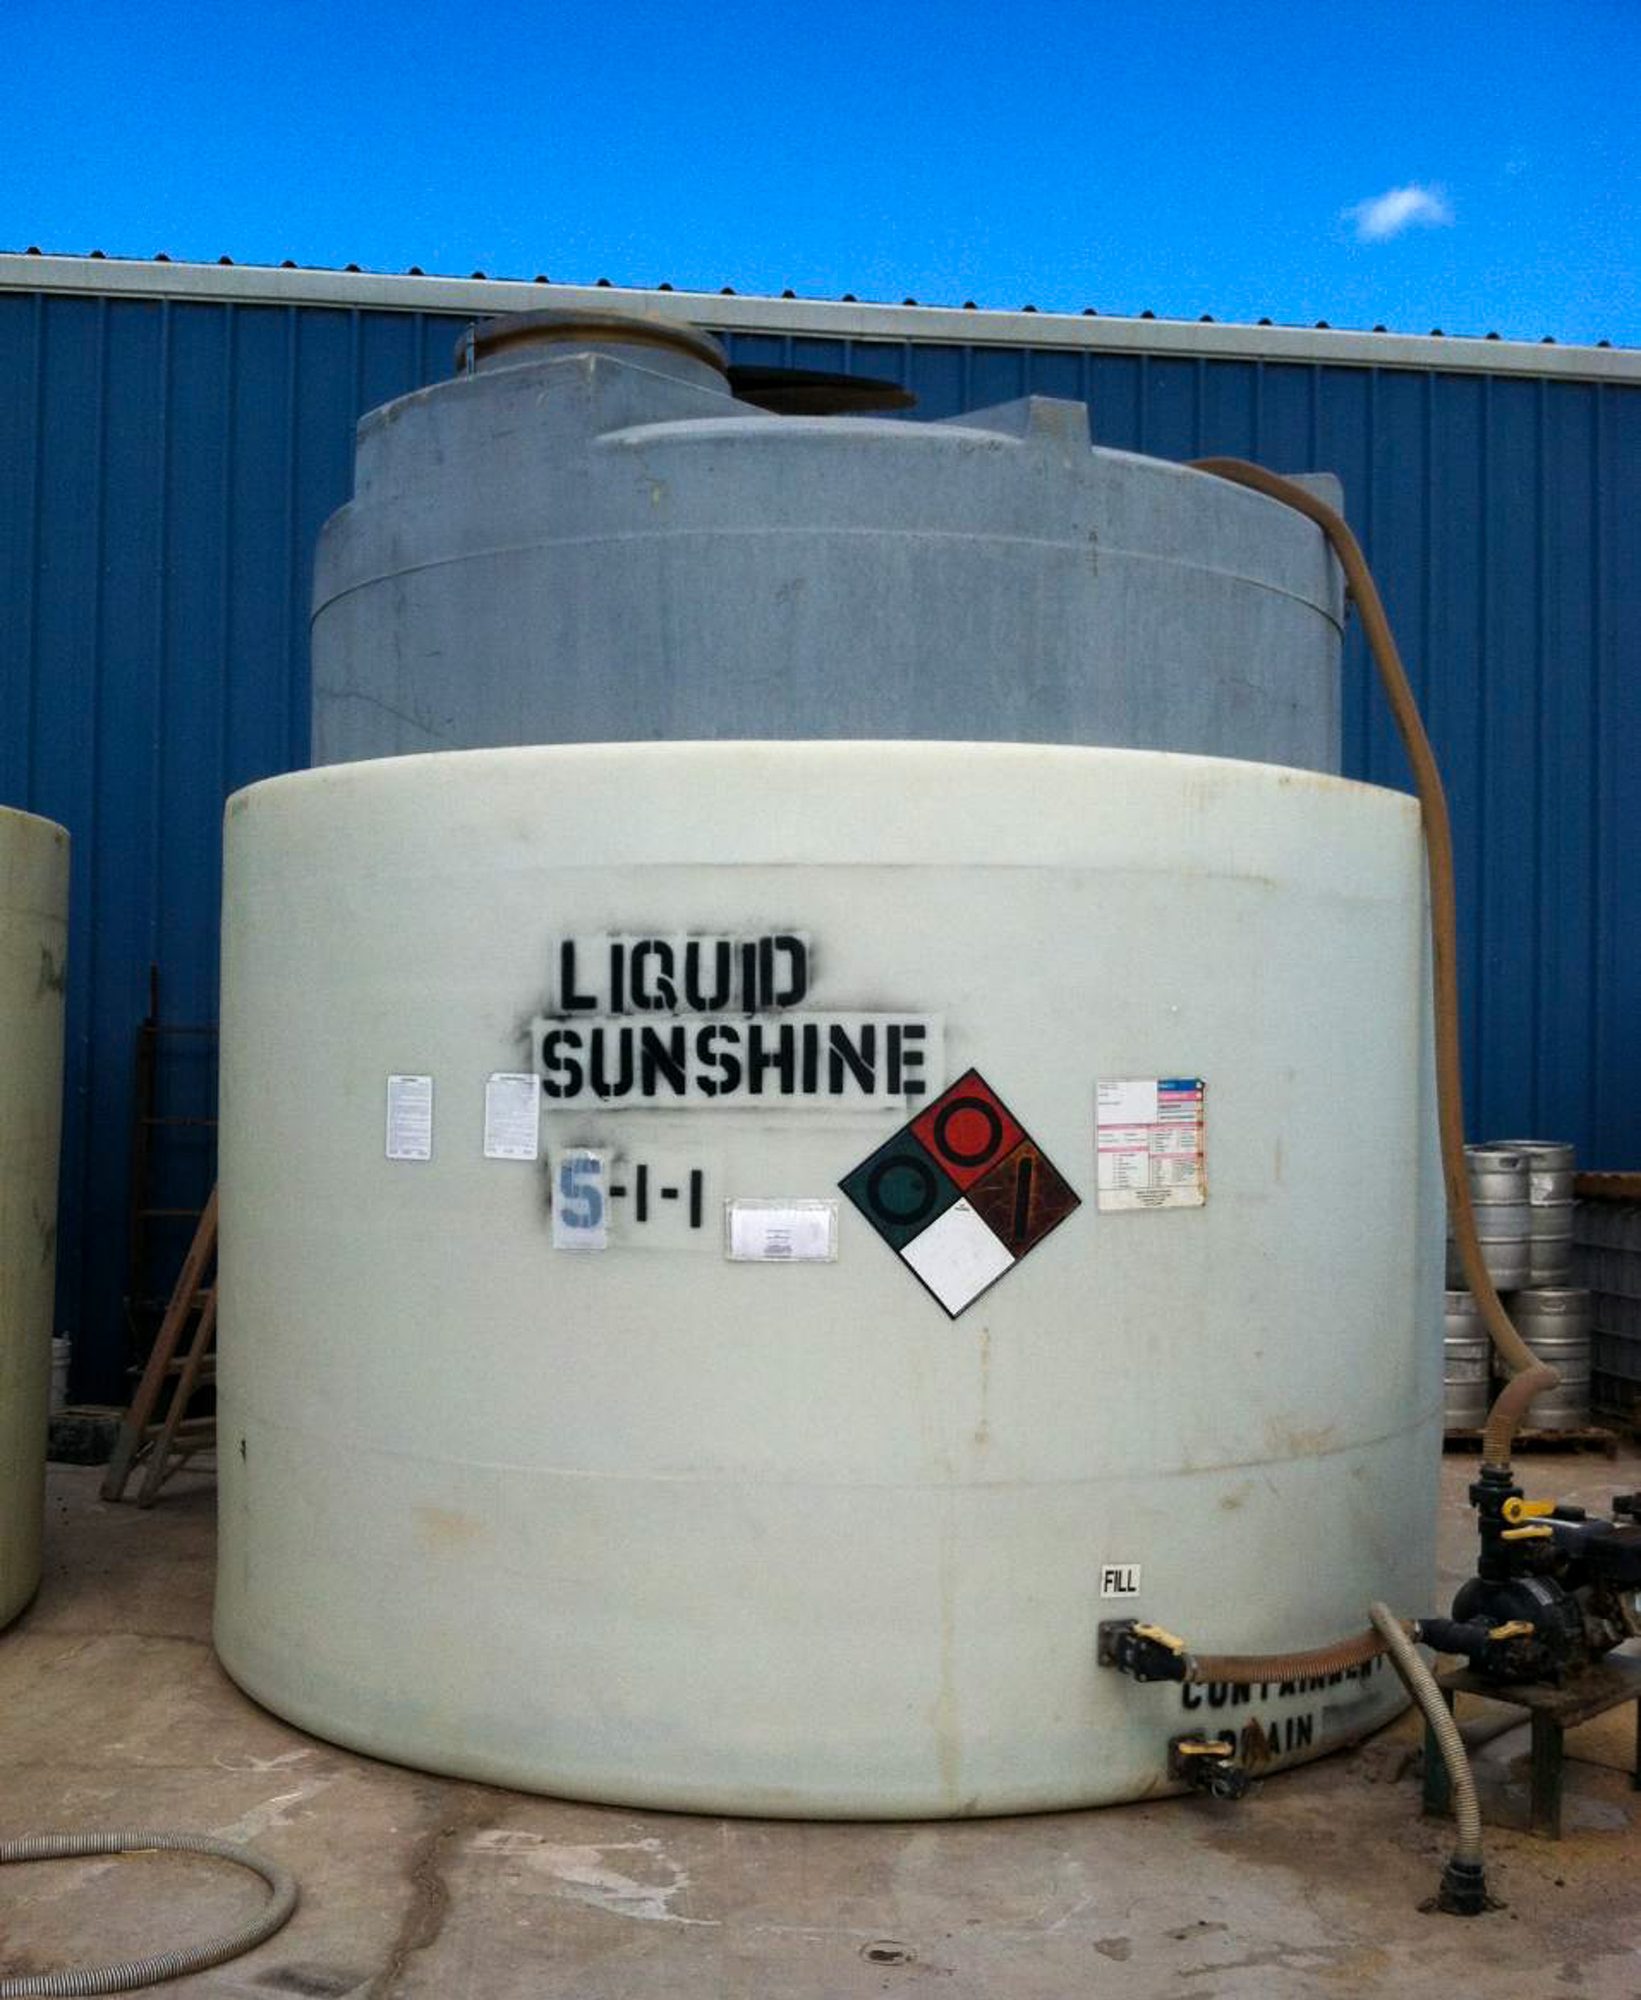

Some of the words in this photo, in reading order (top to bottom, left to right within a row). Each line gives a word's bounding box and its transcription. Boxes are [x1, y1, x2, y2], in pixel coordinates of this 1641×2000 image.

[561, 936, 808, 1013] LIQUID
[542, 1024, 926, 1098] SUNSHINE
[1104, 1569, 1137, 1593] FILL
